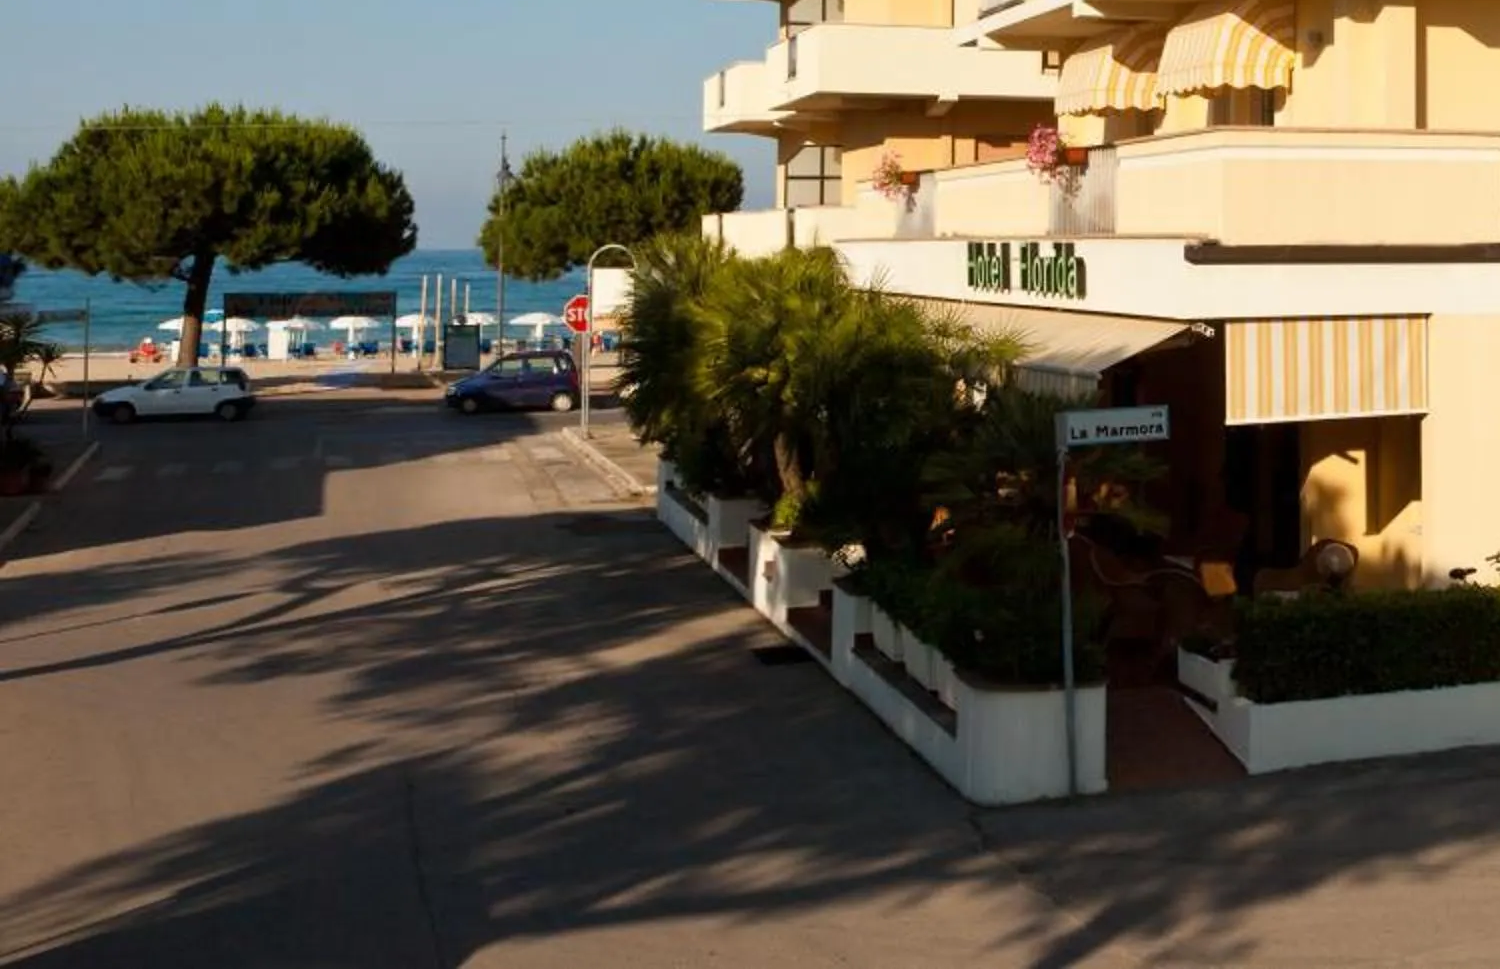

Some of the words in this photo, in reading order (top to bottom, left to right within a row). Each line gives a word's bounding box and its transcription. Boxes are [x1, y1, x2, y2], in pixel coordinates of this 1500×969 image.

[967, 241, 1007, 294] Hotel
[1020, 241, 1083, 299] Florida
[1071, 427, 1088, 439] La
[1096, 423, 1164, 437] Marmora
